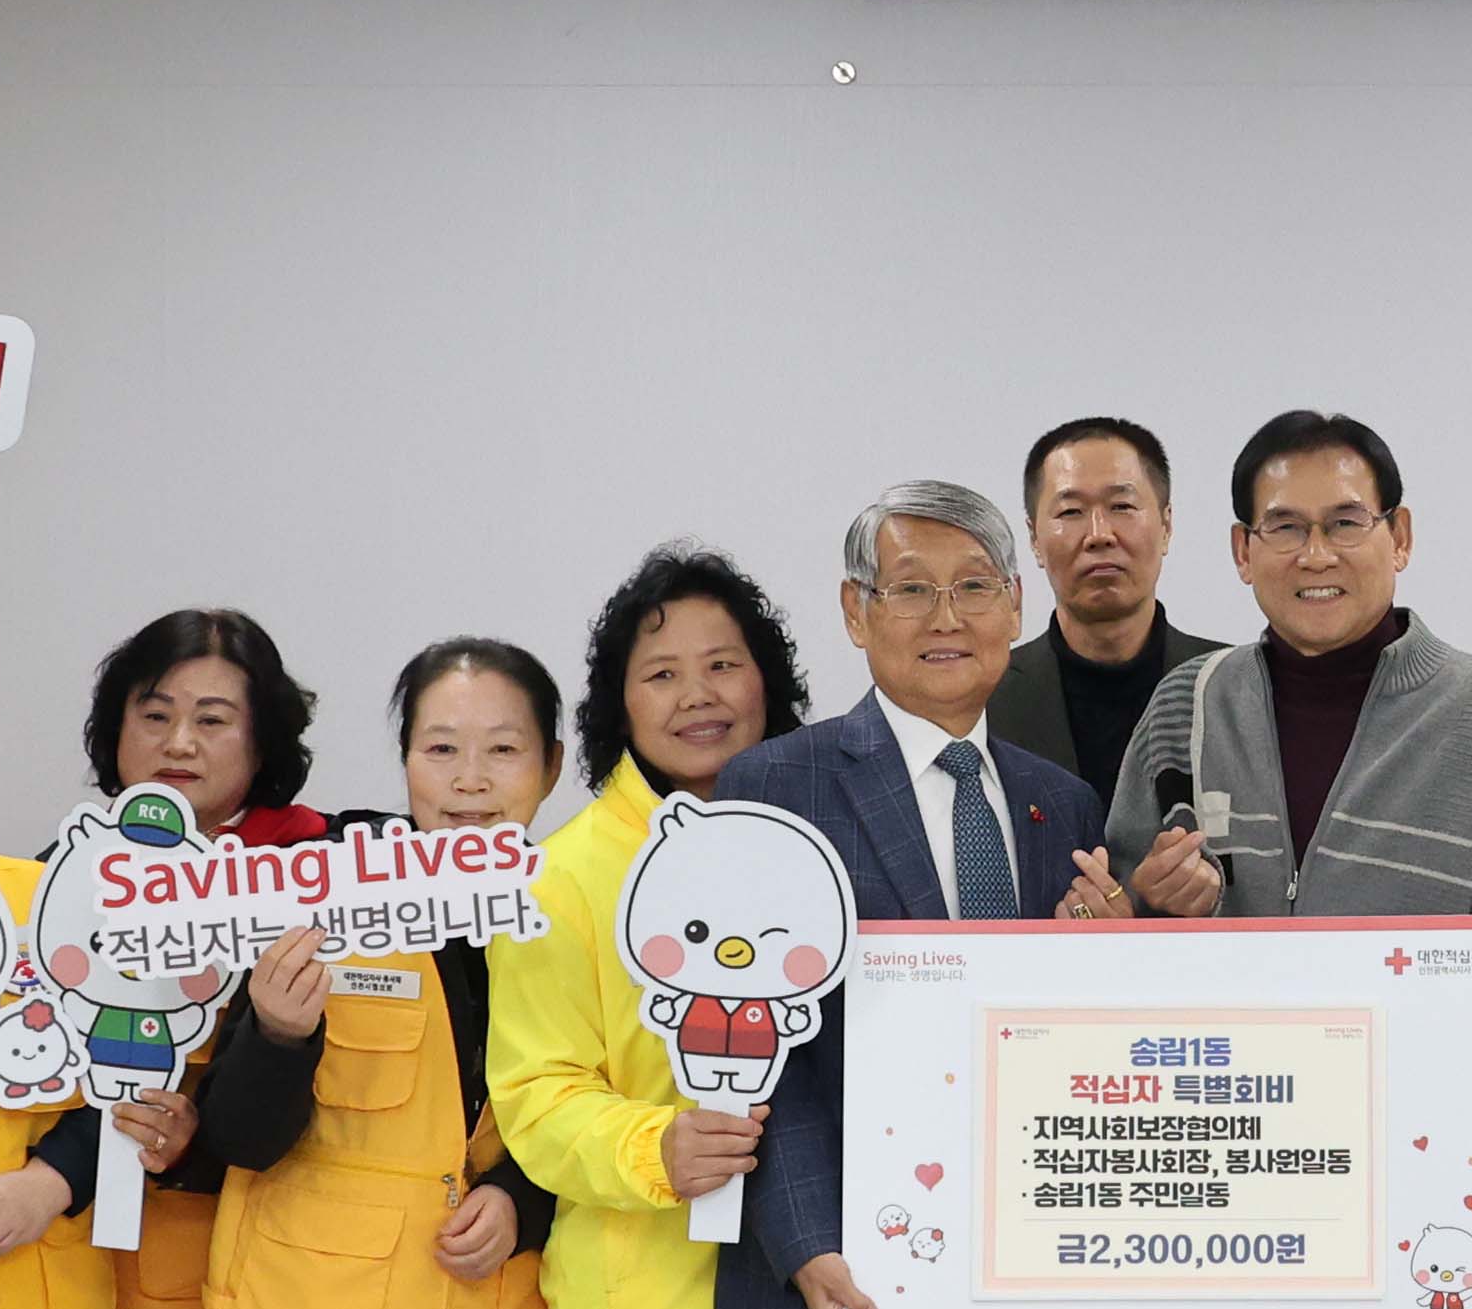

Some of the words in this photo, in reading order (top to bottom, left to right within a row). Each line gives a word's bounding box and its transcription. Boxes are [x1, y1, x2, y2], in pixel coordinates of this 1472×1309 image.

[138, 803, 169, 821] RCY
[100, 843, 332, 909] Saving
[356, 826, 540, 885] Lives,
[108, 916, 288, 973] 적십자는
[312, 888, 544, 954] 생명입니다.
[862, 951, 918, 970] Saving
[922, 950, 967, 968] Lives,
[1129, 1036, 1232, 1067] 송림1동
[1069, 1074, 1164, 1105] 적십자
[1172, 1074, 1294, 1105] 특별회비
[1033, 1115, 1262, 1142] 지역사회보장협의체
[1033, 1148, 1219, 1179] 적십자봉사회장,
[1225, 1148, 1352, 1175] 봉사원일동
[1033, 1181, 1123, 1209] 송림1동
[1128, 1181, 1231, 1208] 주민일동
[1056, 1233, 1306, 1269] 금2,300,000원
